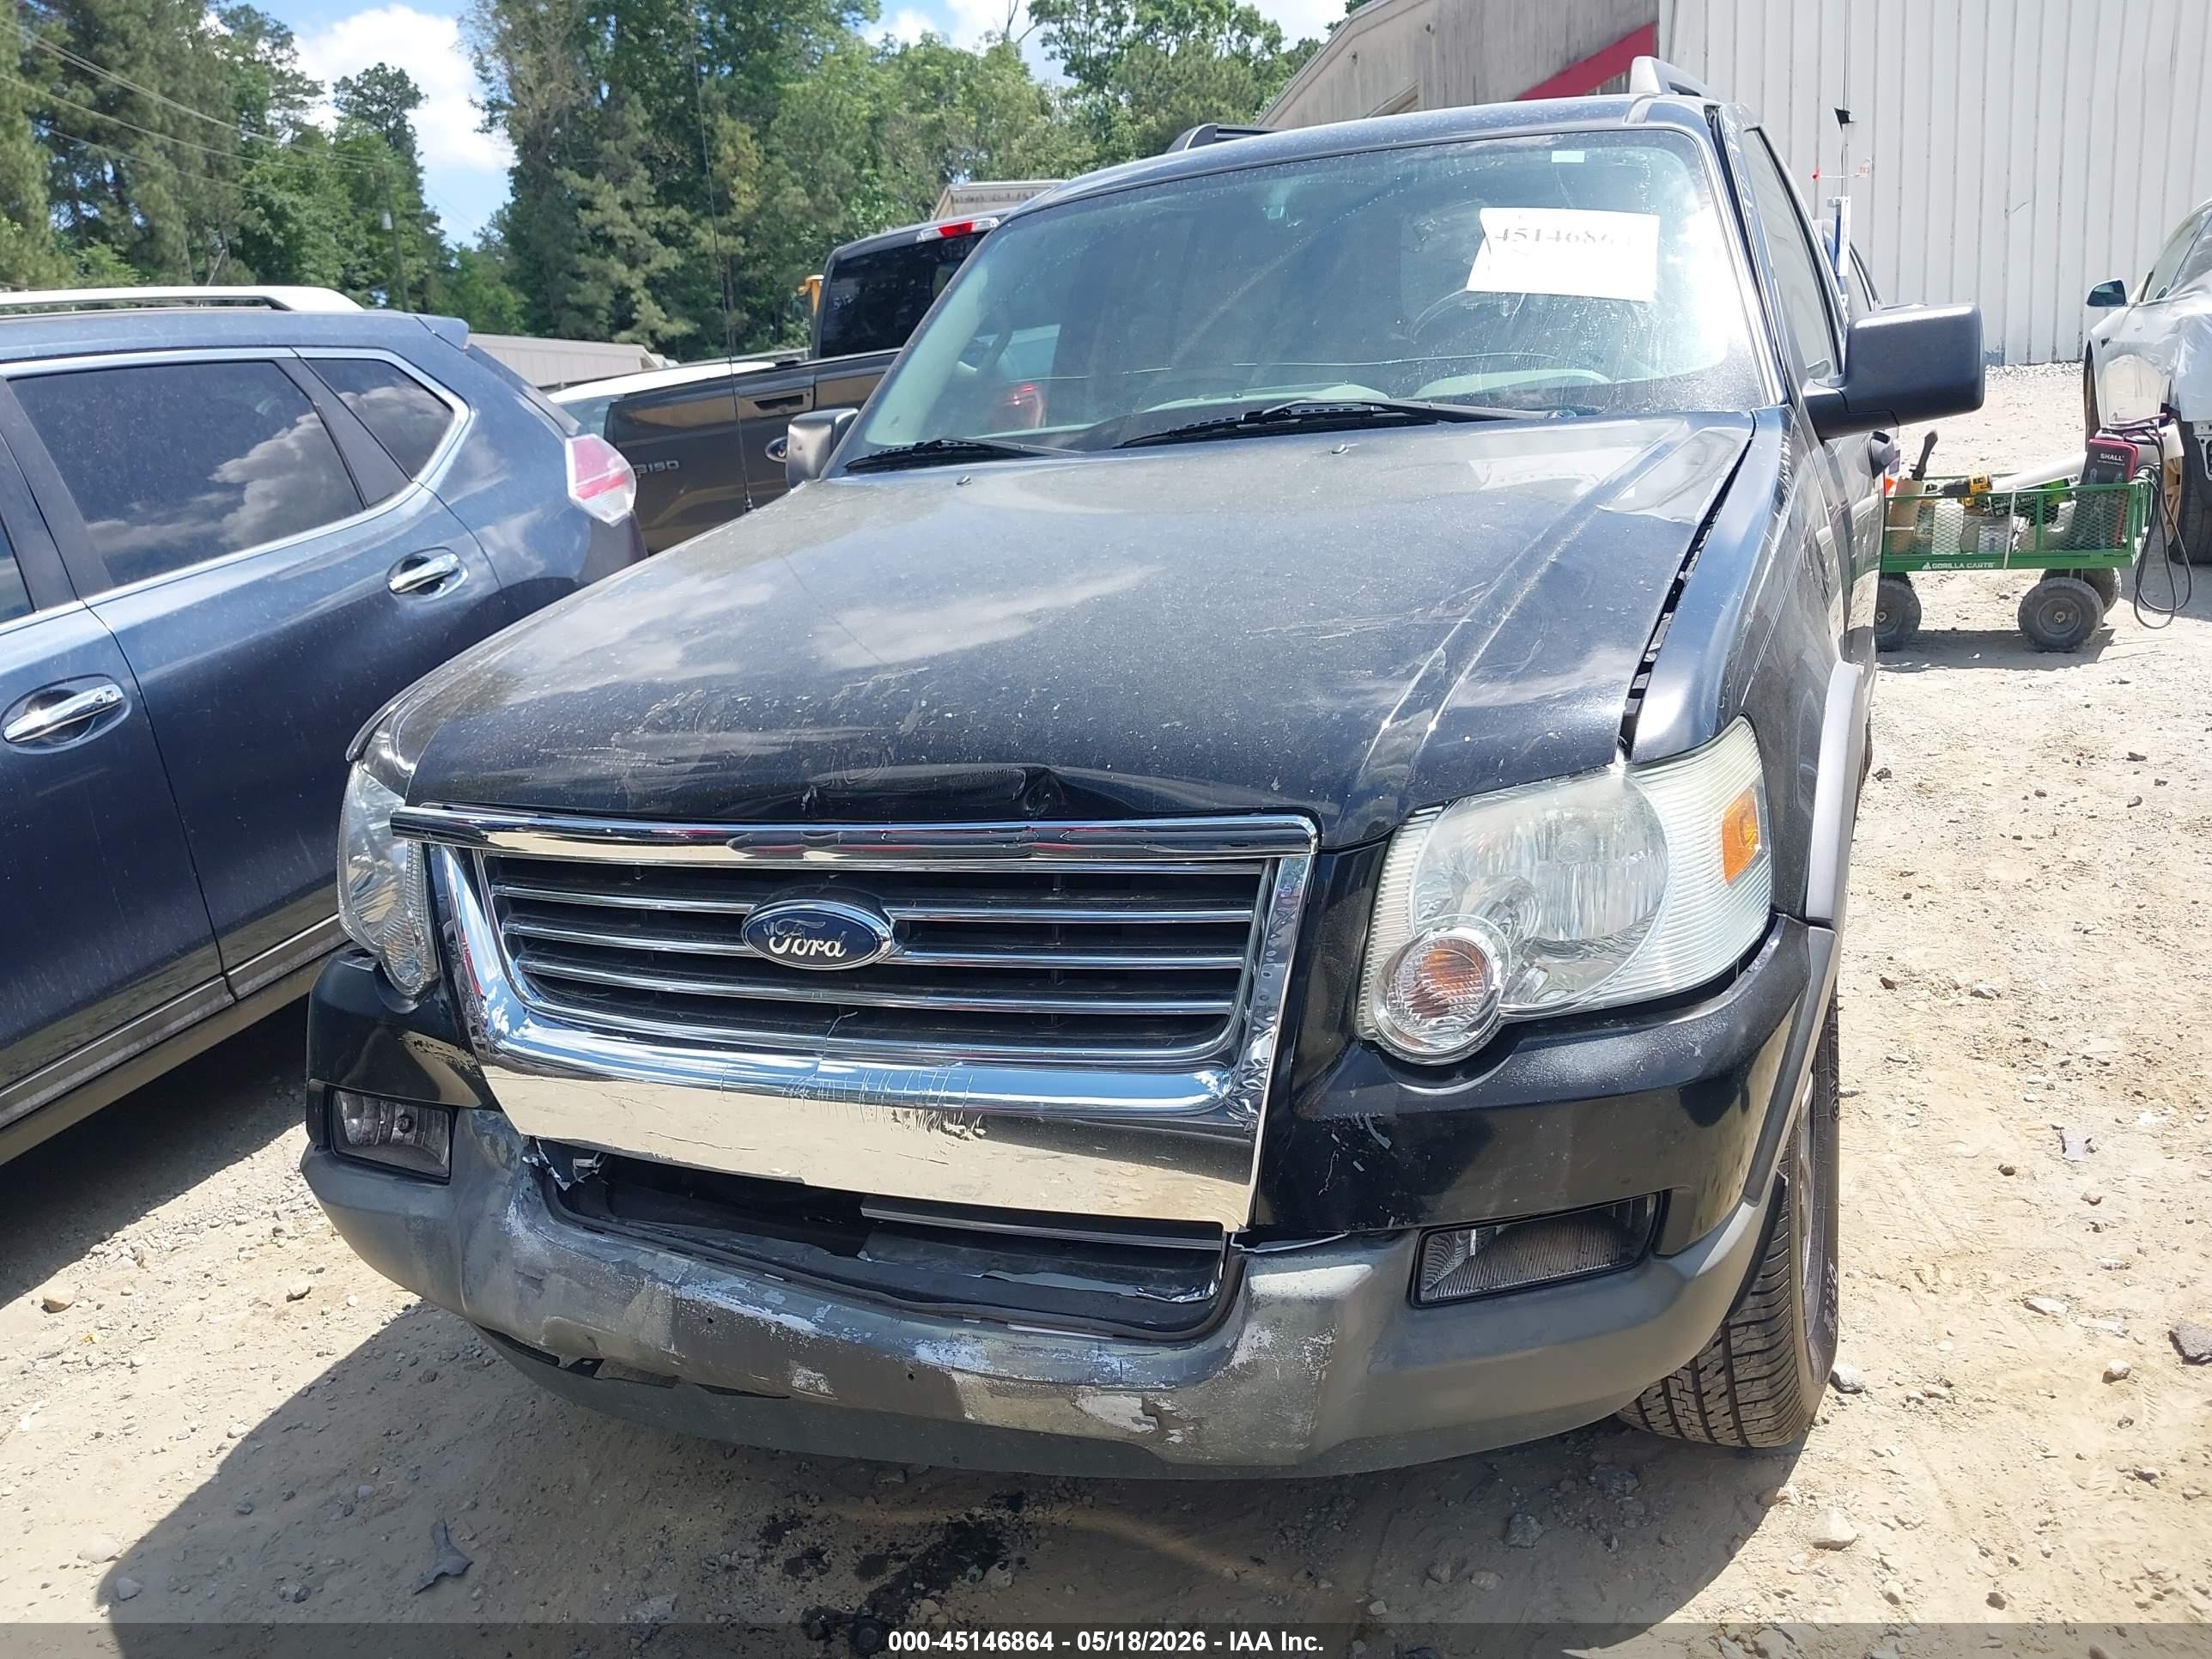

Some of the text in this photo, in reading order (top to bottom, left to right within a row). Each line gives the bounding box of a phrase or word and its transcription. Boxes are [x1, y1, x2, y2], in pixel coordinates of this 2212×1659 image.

[1494, 228, 1634, 247] 4514686
[2100, 453, 2124, 461] SHALL
[763, 918, 848, 958] Ford
